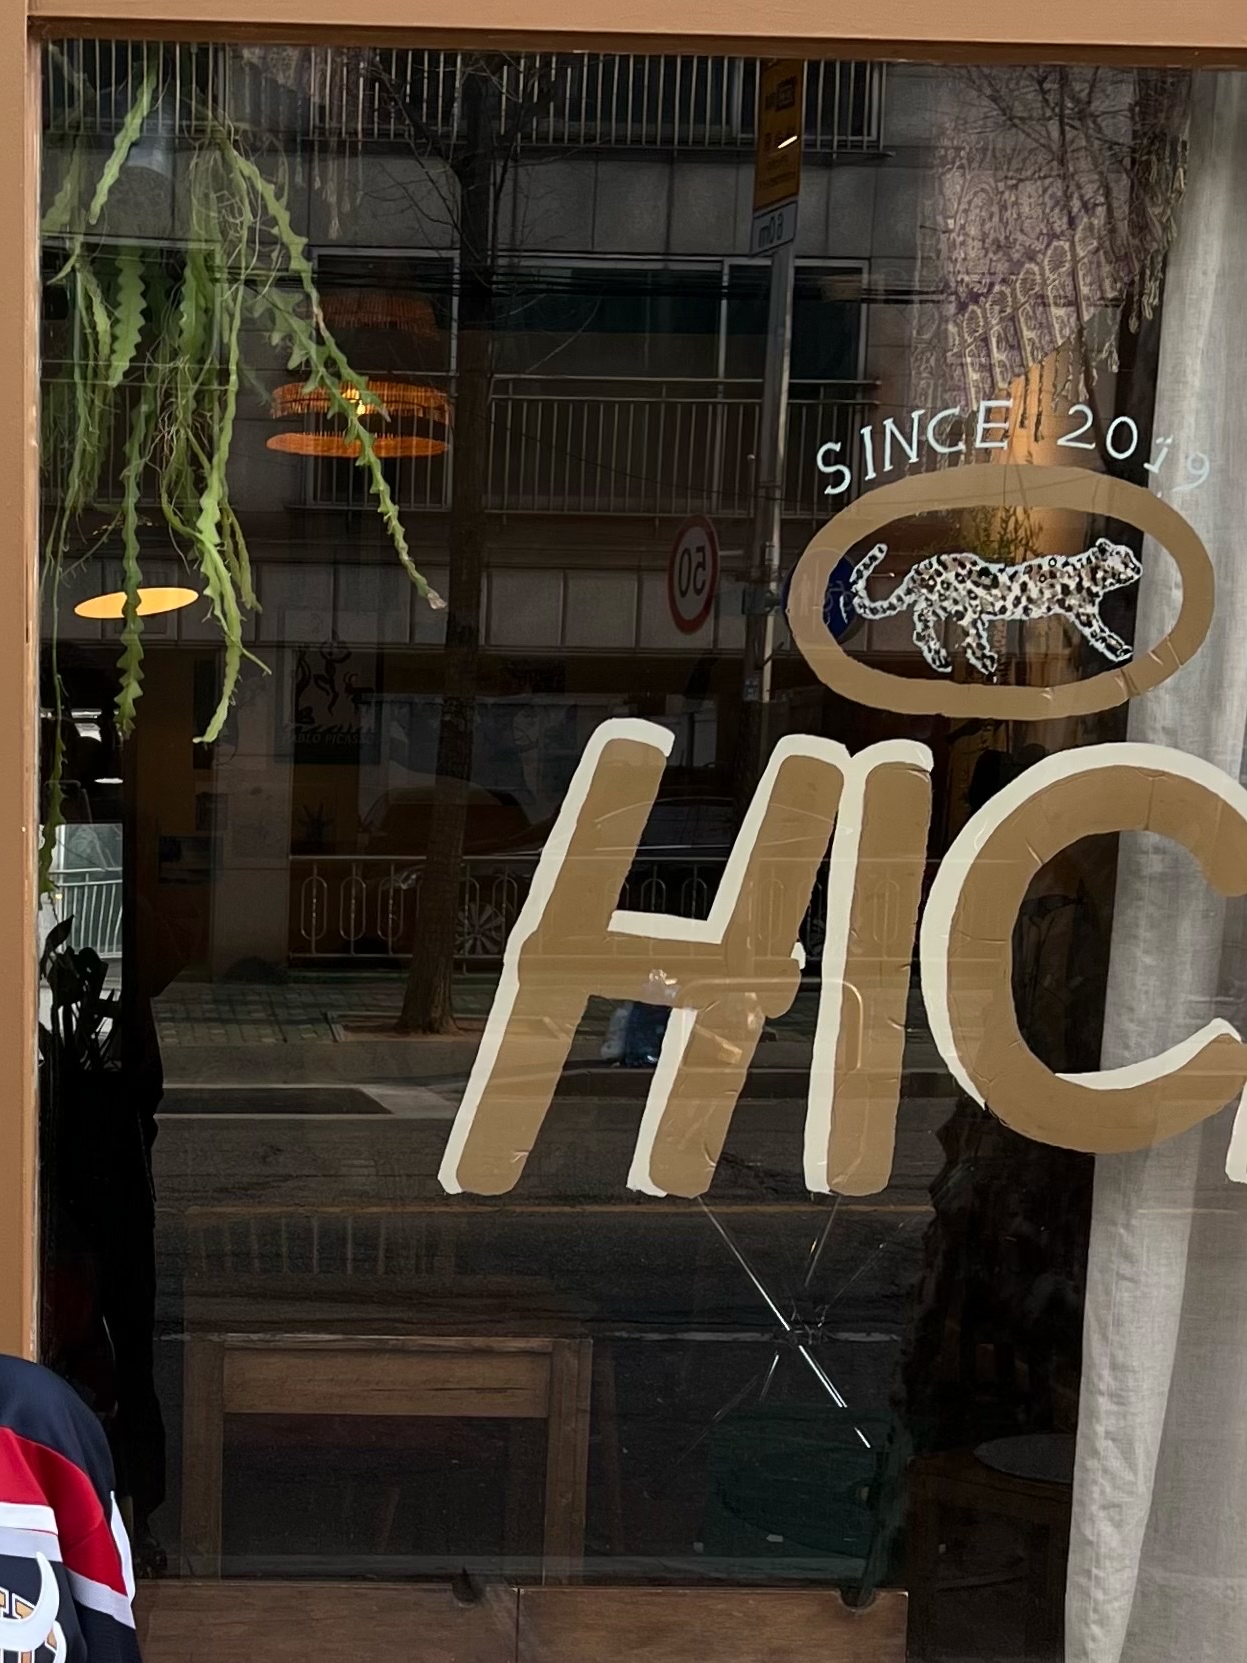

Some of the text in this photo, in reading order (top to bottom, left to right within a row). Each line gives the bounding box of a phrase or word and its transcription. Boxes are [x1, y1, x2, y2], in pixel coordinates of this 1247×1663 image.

[816, 398, 1211, 495] SINCE 2019
[438, 717, 1247, 1197] HIC
